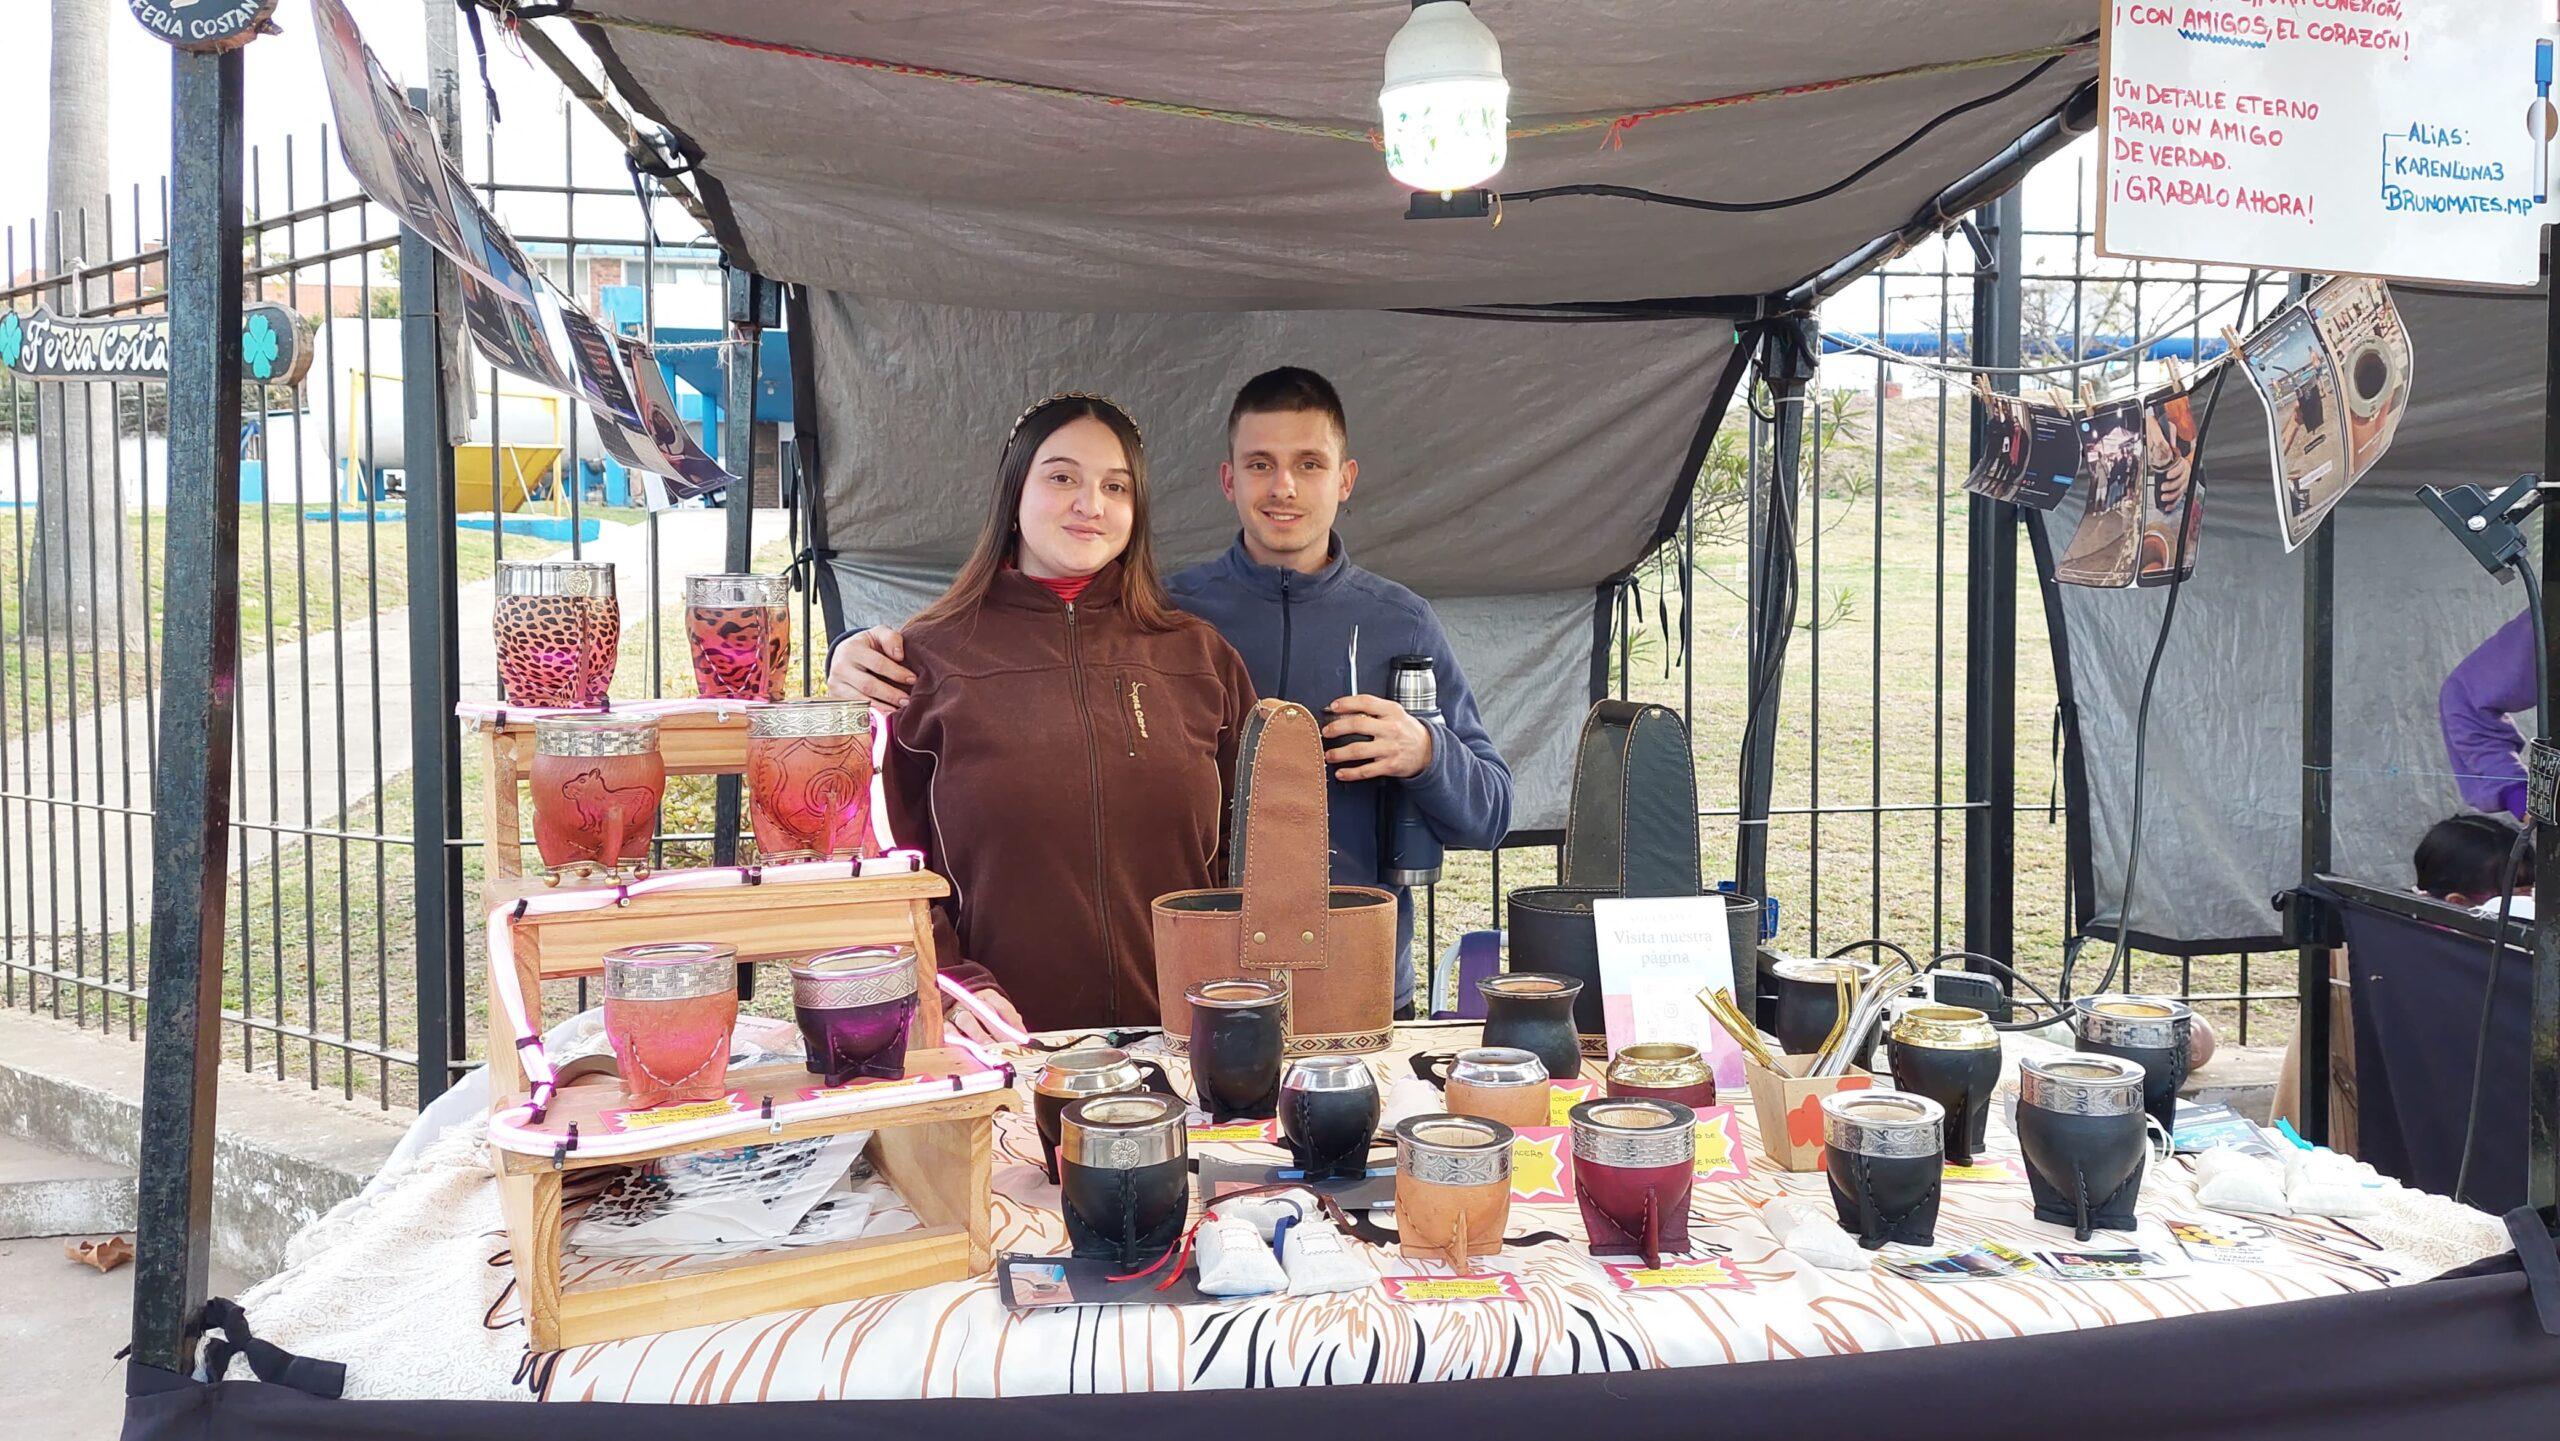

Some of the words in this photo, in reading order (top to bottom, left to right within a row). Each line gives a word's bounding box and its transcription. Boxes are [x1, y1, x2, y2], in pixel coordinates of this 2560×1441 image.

[2277, 18, 2299, 40] EL
[2113, 76, 2141, 101] UN
[2146, 83, 2226, 110] DETALLE
[2236, 95, 2319, 121] ETERNO
[2113, 105, 2165, 134] PARA
[2172, 117, 2202, 136] UN
[2210, 118, 2283, 147] AMIGO
[2114, 136, 2144, 163] DE
[2149, 145, 2231, 170] VERDAD.
[2235, 186, 2314, 225] AHORA!
[22, 319, 97, 373] Feria
[1613, 930, 1655, 945] Visita
[1660, 932, 1713, 944] nuestra
[1513, 1149, 1544, 1159] ACERO
